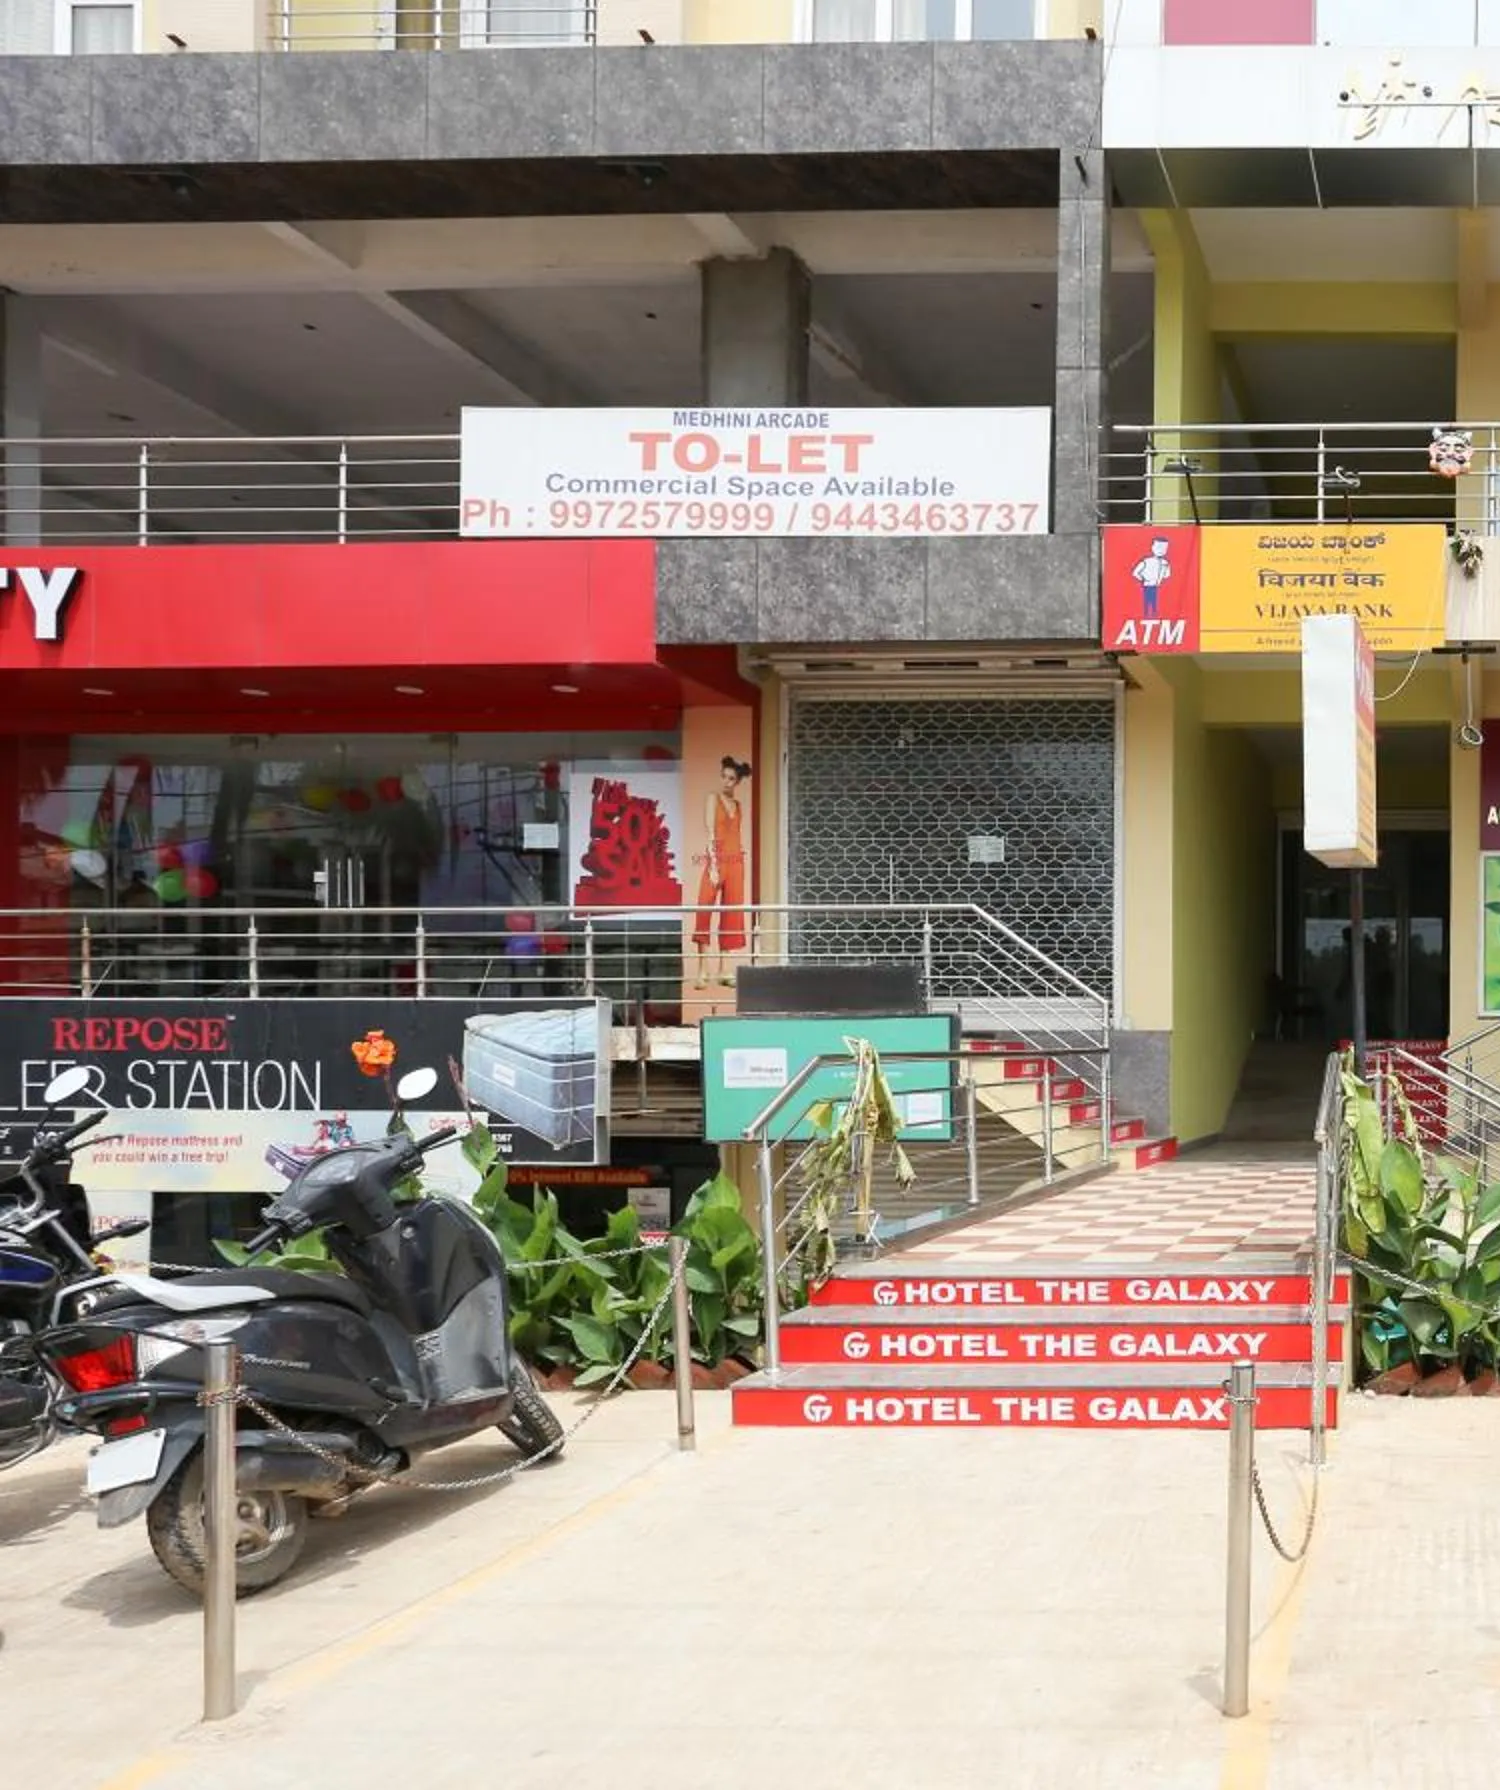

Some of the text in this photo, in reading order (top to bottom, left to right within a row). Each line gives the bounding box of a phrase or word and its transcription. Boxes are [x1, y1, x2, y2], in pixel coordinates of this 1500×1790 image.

[673, 411, 830, 428] MEDHINI ARCADE
[629, 432, 874, 474] TO-LET
[545, 473, 955, 499] Commercial Space Available
[462, 499, 510, 529] Ph
[548, 500, 775, 532] 9972579999
[809, 502, 1039, 533] 9443463737
[0, 566, 79, 640] Y
[1255, 603, 1393, 618] VIJAYA BANK
[1115, 619, 1187, 646] ATM
[51, 1016, 229, 1052] REPOSE
[125, 1059, 321, 1110] STATION
[127, 1135, 168, 1147] Repose
[171, 1135, 218, 1146] mattress
[222, 1134, 243, 1146] and
[92, 1153, 112, 1163] you
[115, 1151, 145, 1162] could
[149, 1152, 168, 1162] win
[181, 1151, 202, 1162] free
[905, 1281, 1025, 1304] HOTEL
[1036, 1280, 1109, 1302] THE
[1125, 1279, 1276, 1302] GALAXY
[881, 1333, 1008, 1358] HOTEL
[1020, 1333, 1097, 1357] THE
[1109, 1332, 1267, 1357] GALAXY
[846, 1397, 981, 1423] HOTEL
[993, 1396, 1074, 1422] THE
[1088, 1396, 1228, 1422] GALAX
